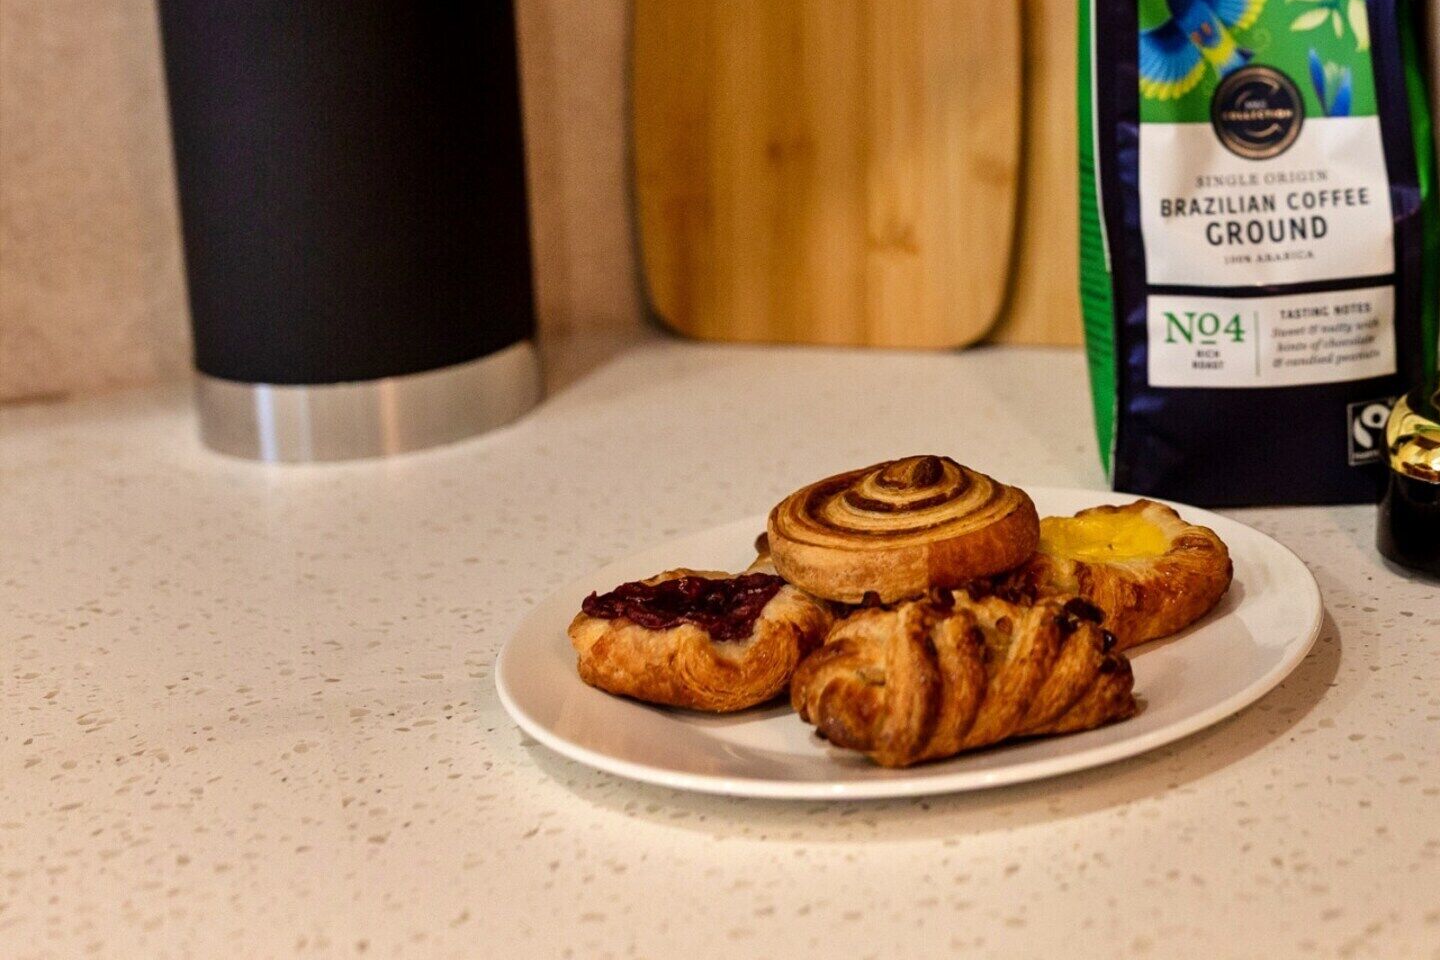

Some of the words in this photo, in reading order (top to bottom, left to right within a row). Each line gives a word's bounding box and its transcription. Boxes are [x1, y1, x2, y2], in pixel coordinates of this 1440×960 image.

[1196, 172, 1260, 189] SINGLE
[1264, 169, 1328, 185] ORIGIN
[1160, 195, 1275, 218] BRAZILIAN
[1287, 187, 1370, 211] COFFEE
[1206, 216, 1328, 246] GROUND
[1255, 250, 1314, 263] ARABICA
[1280, 306, 1329, 319] TASTING
[1334, 302, 1372, 315] NOTES
